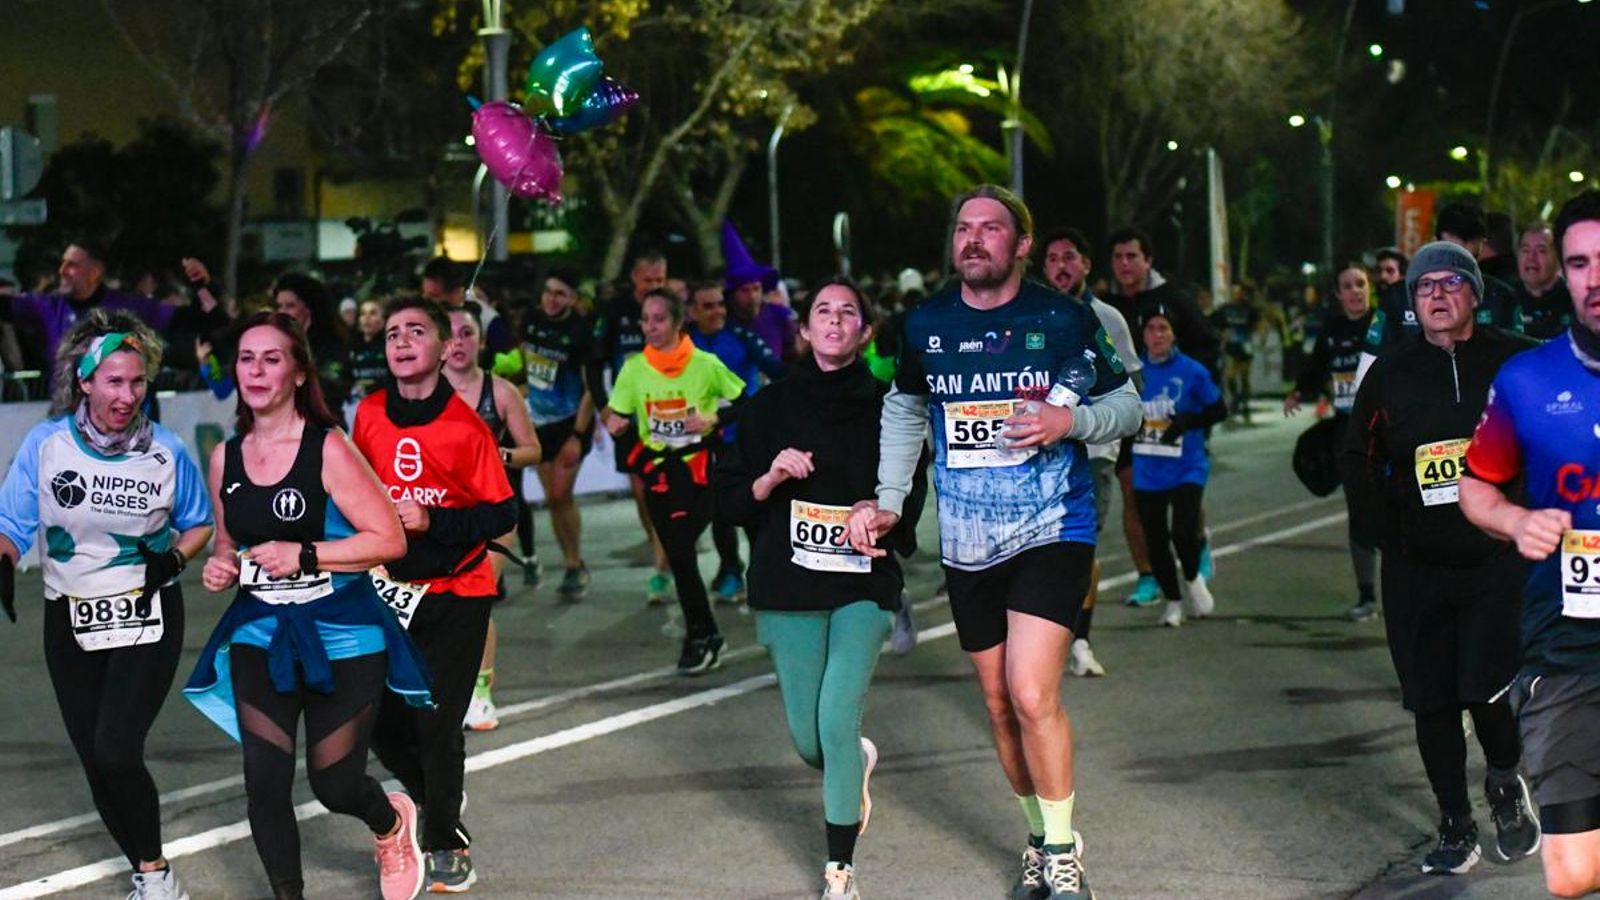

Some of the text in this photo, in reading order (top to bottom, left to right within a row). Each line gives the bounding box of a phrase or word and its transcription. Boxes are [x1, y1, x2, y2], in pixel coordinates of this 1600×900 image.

[926, 366, 1050, 394] SAN ANTÓN
[92, 475, 161, 496] NIPPON
[91, 491, 149, 510] GASES
[797, 521, 854, 547] 608
